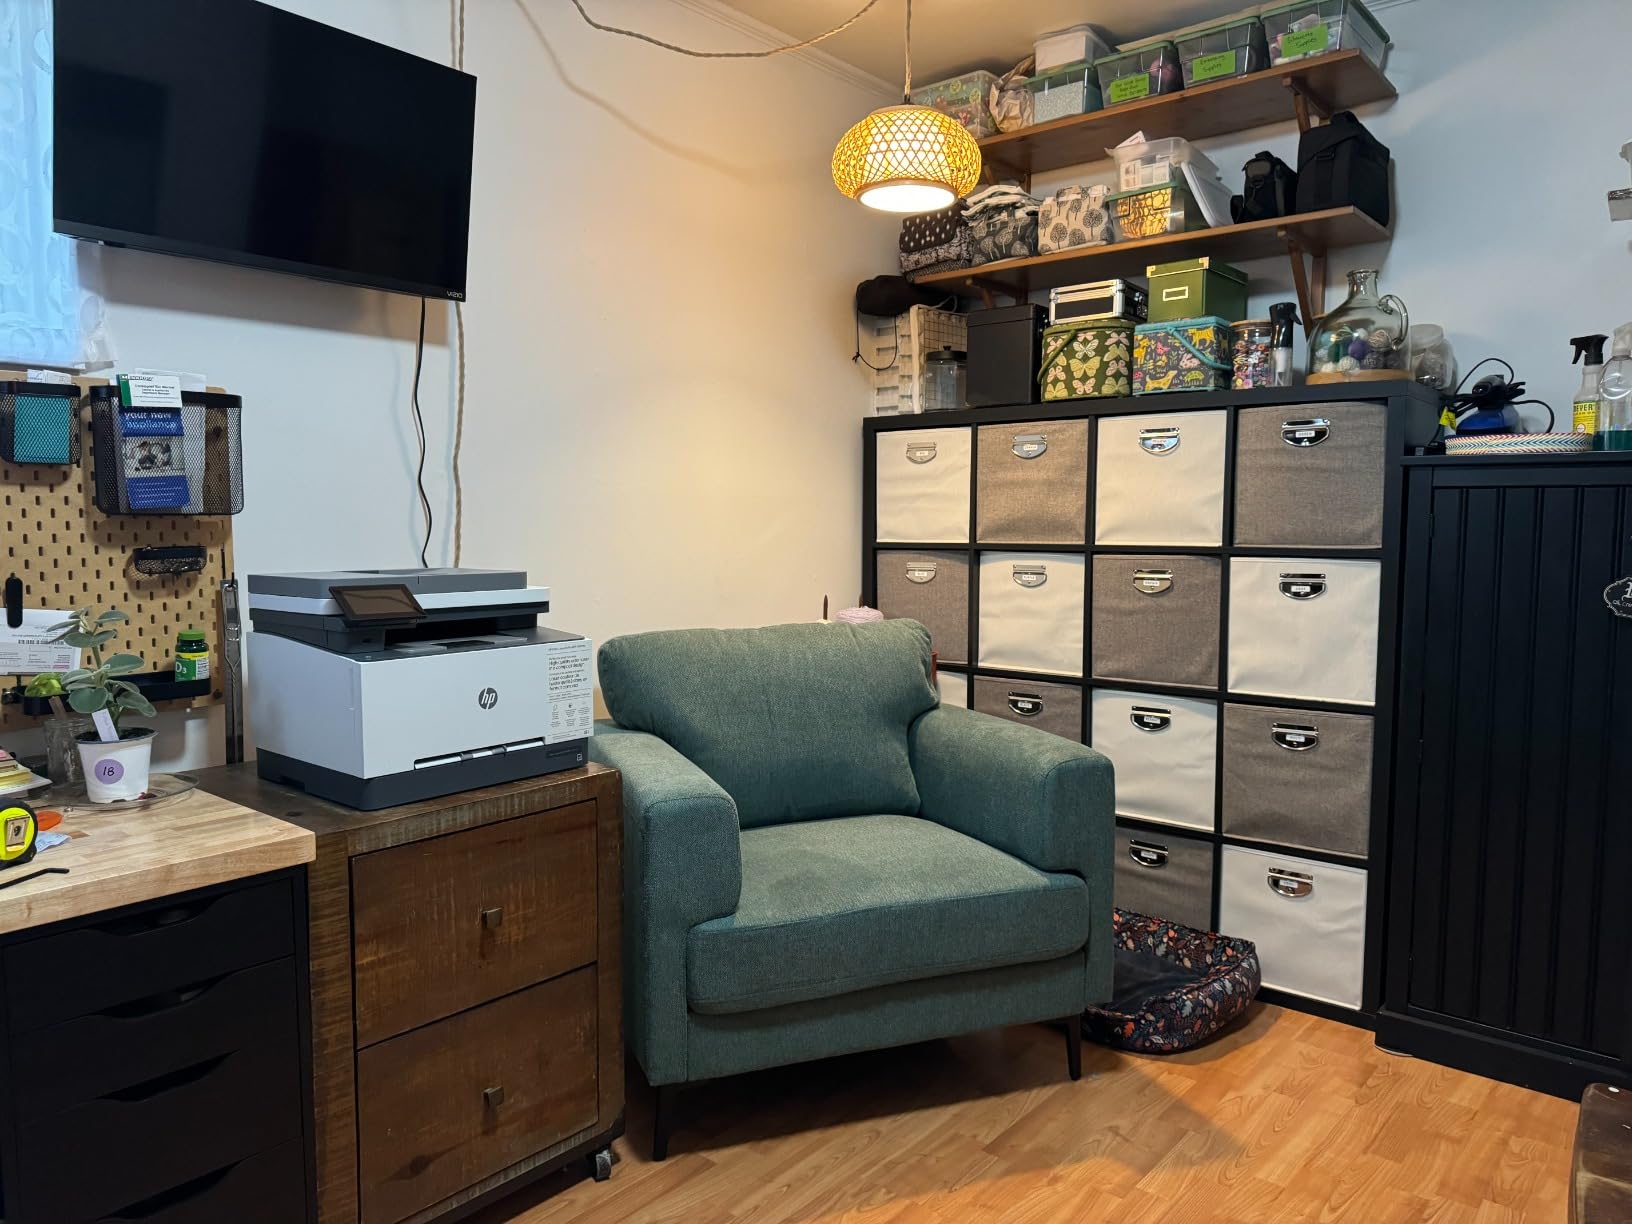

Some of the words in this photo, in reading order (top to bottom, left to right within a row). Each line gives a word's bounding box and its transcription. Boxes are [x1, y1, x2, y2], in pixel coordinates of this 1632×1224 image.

[124, 411, 146, 421] your
[150, 411, 171, 420] new
[479, 687, 498, 709] hp
[102, 766, 115, 777] 18
